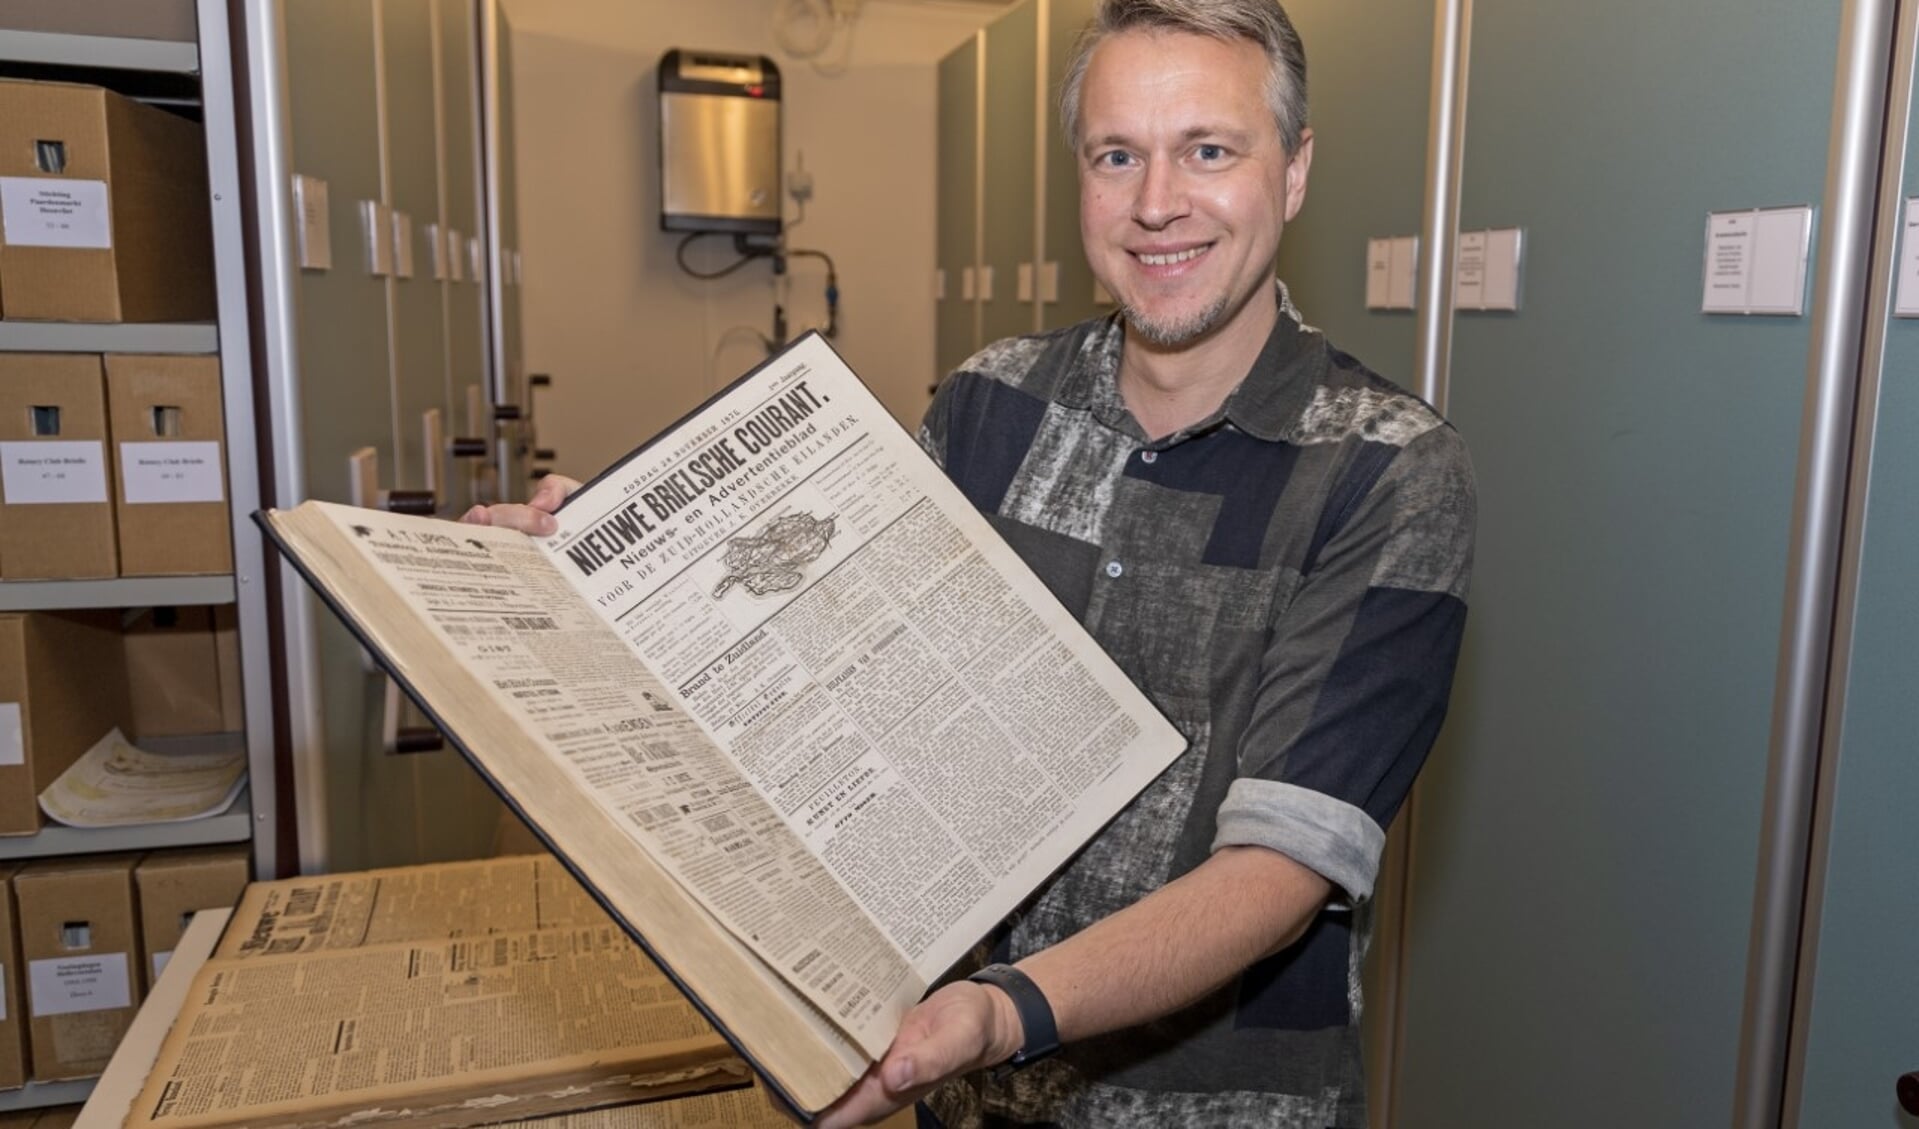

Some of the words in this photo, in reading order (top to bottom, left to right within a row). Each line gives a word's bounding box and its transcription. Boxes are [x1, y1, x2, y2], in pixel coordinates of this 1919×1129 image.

[566, 502, 656, 576] NIEUWE
[641, 438, 747, 522] BRIELSCHE
[734, 381, 830, 455] COURANT.
[620, 527, 678, 570] Nieuws-
[684, 508, 703, 524] en
[708, 422, 817, 506] Advertentieblad
[623, 468, 659, 494] ZONDAG
[674, 425, 718, 458] NOVEMBER
[597, 580, 634, 607] VOOR
[637, 563, 656, 580] DE
[659, 465, 790, 564] ZUID-HOLLANDSCHE
[680, 673, 712, 699] Brand
[712, 664, 724, 674] te
[806, 801, 834, 826] KUNST
[835, 790, 847, 801] EN
